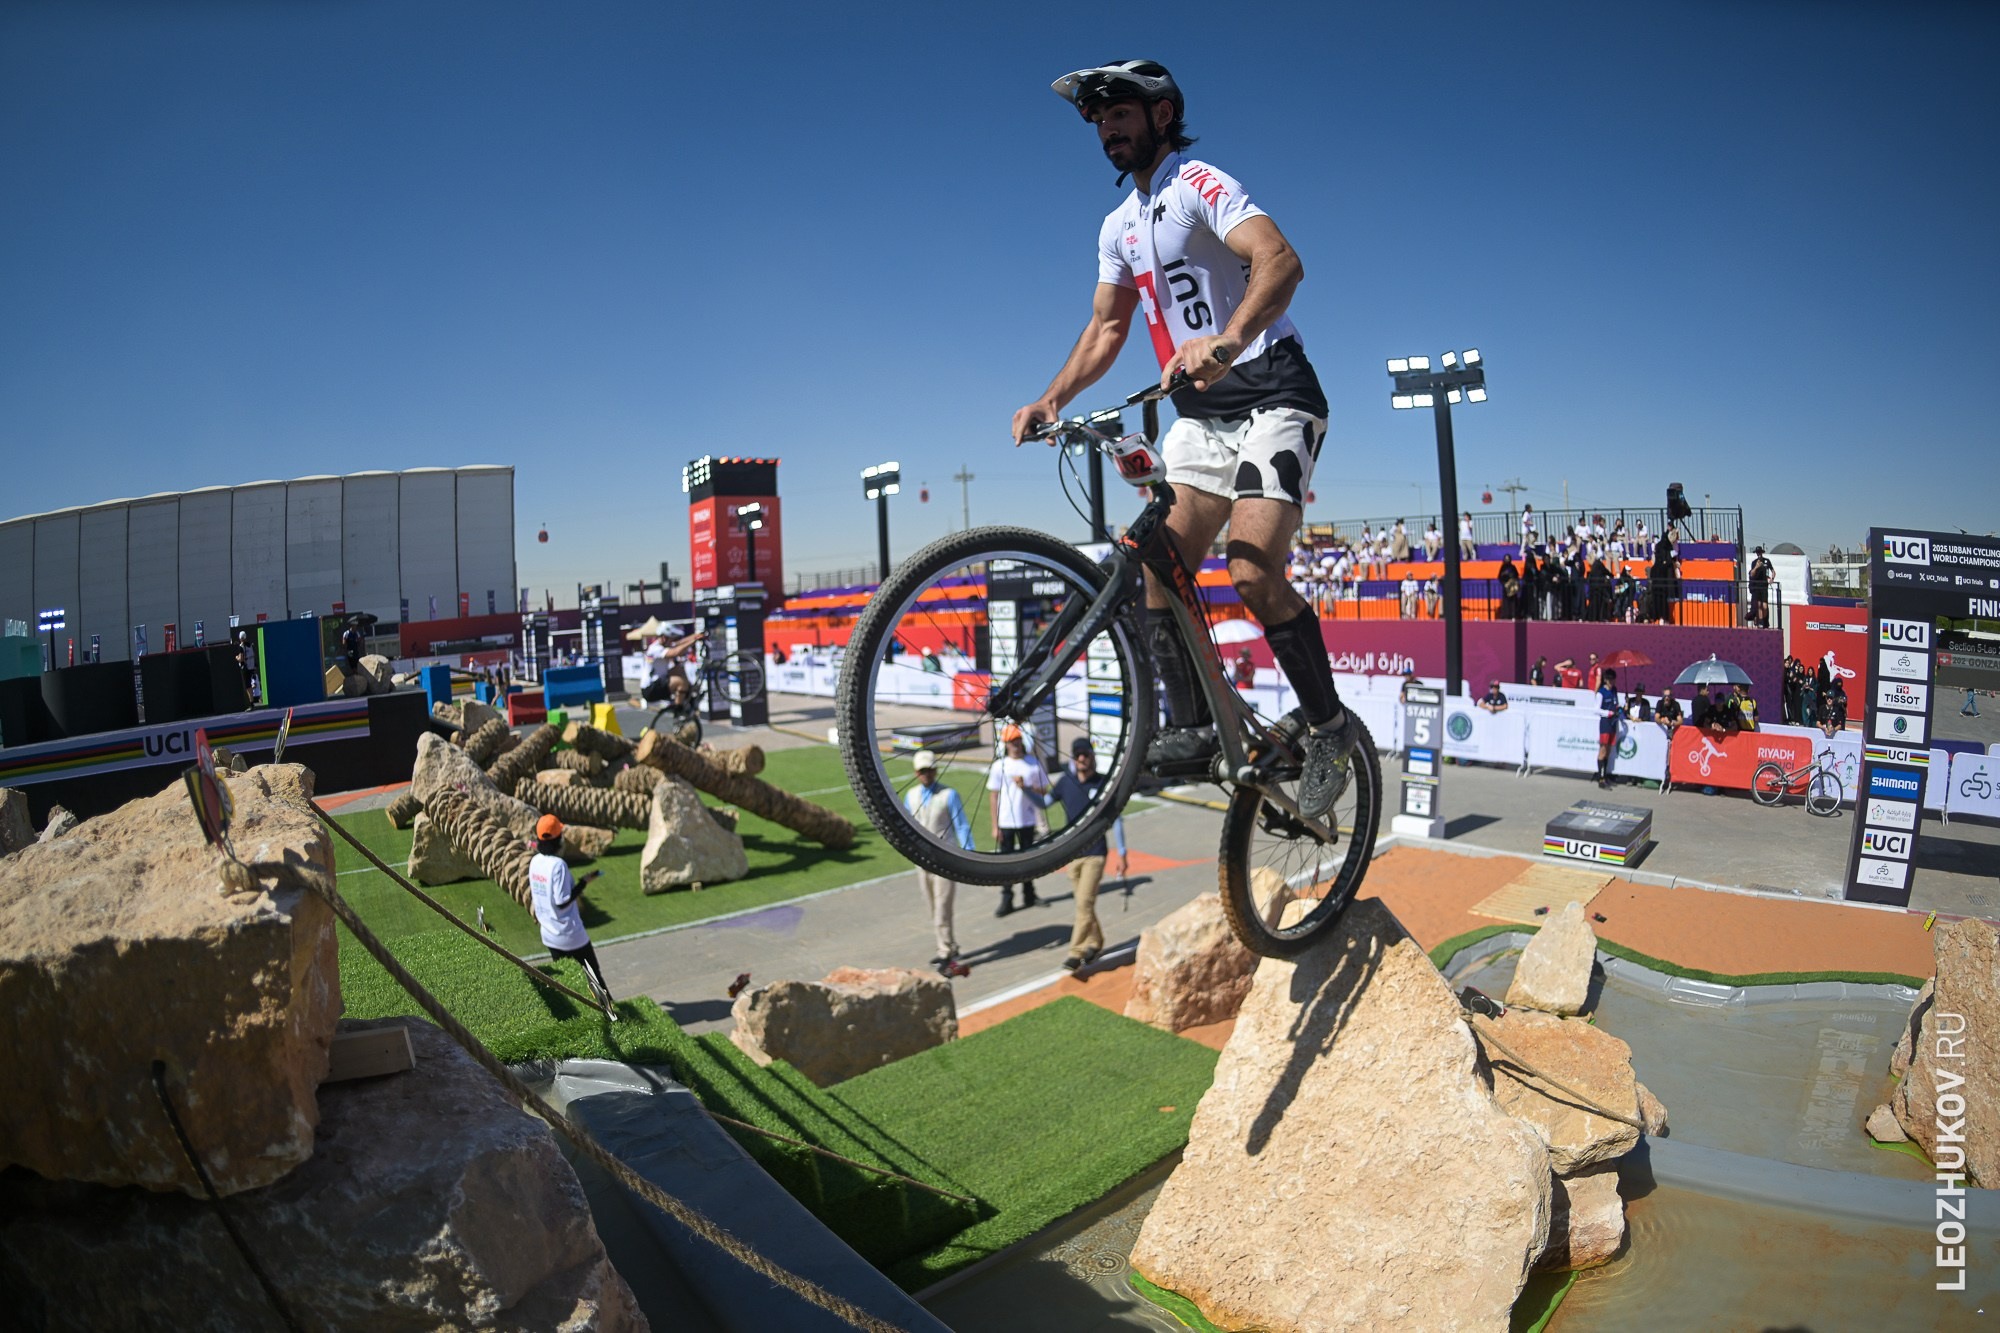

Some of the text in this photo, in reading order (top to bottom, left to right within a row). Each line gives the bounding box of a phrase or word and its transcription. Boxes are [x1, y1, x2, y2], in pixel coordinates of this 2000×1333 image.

[1891, 540, 1926, 560] UCI
[1932, 544, 1948, 552] 2025
[1948, 545, 1972, 555] URBAN
[1932, 553, 1958, 564] WORLD
[1968, 597, 2000, 618] FINI
[1890, 623, 1924, 643] UCI
[1884, 693, 1920, 705] TISSOT
[1406, 705, 1439, 719] START
[1413, 718, 1431, 745] 5
[145, 730, 190, 756] UCI
[1757, 747, 1795, 760] RIYADH
[1888, 750, 1907, 761] UCI
[1871, 776, 1918, 791] SHIMANO
[1566, 841, 1597, 858] UCI
[1872, 834, 1906, 854] UCI
